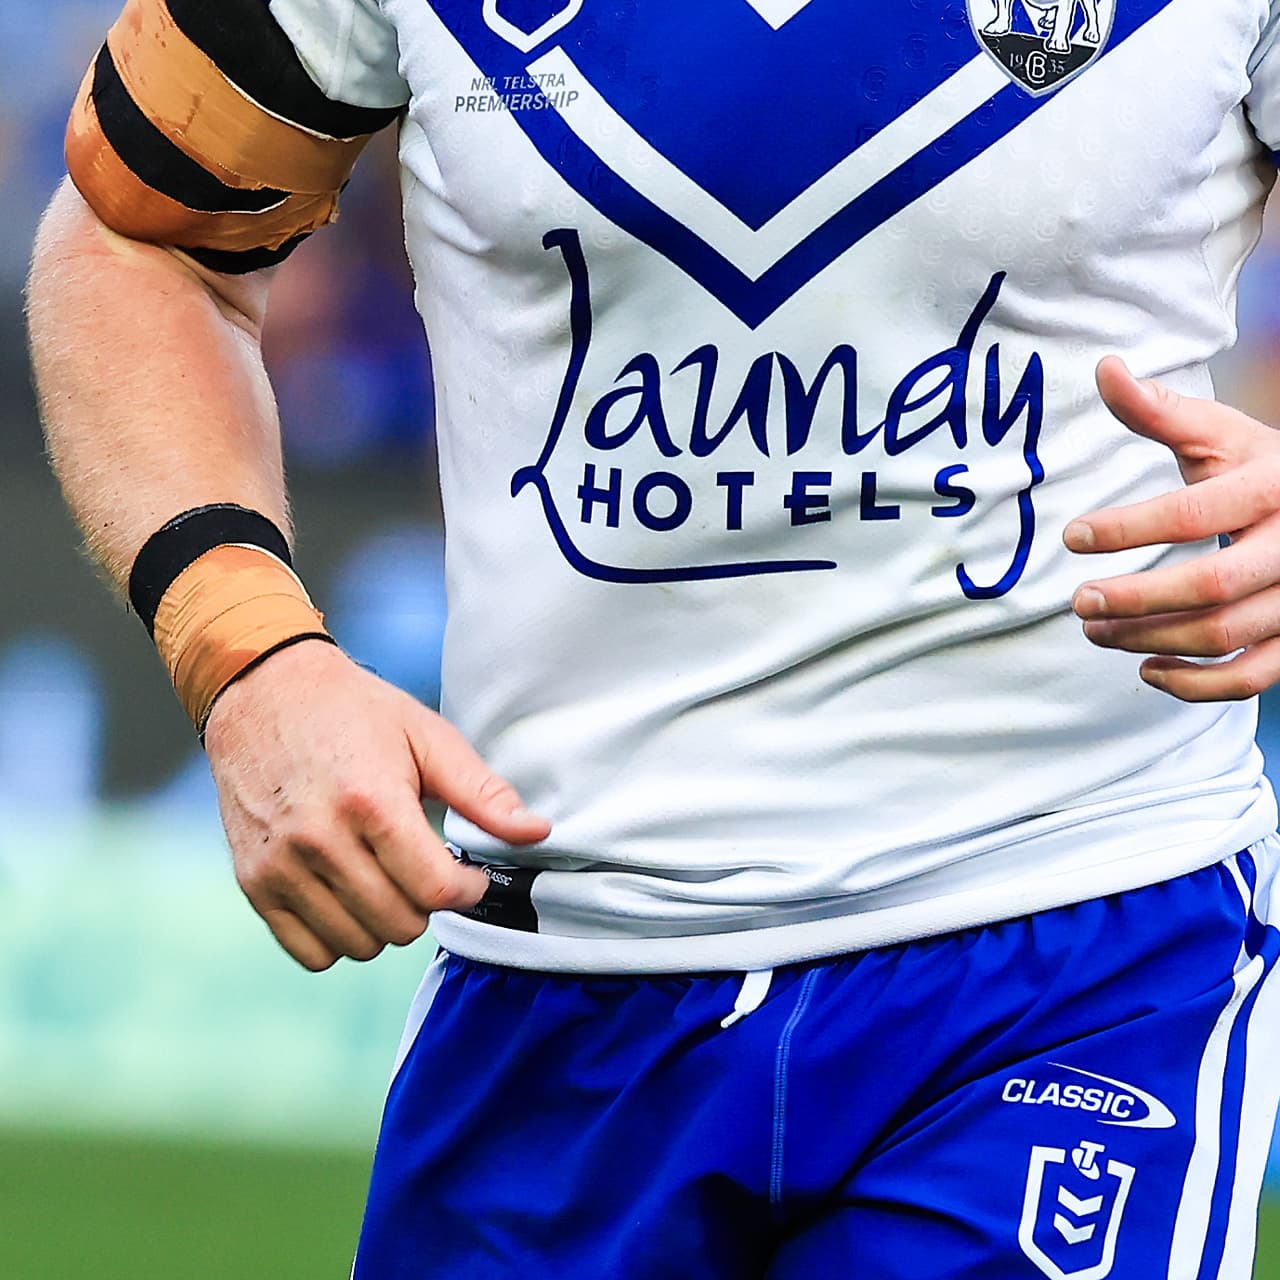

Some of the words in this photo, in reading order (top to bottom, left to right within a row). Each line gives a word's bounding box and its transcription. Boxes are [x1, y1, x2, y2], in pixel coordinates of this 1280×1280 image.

[454, 89, 580, 113] PREMIERSHIP
[470, 76, 498, 91] NRL
[503, 73, 566, 90] TELSTRA
[510, 228, 1045, 600] Laundy
[576, 463, 976, 532] HOTELS
[1001, 1077, 1136, 1119] CLASSIC
